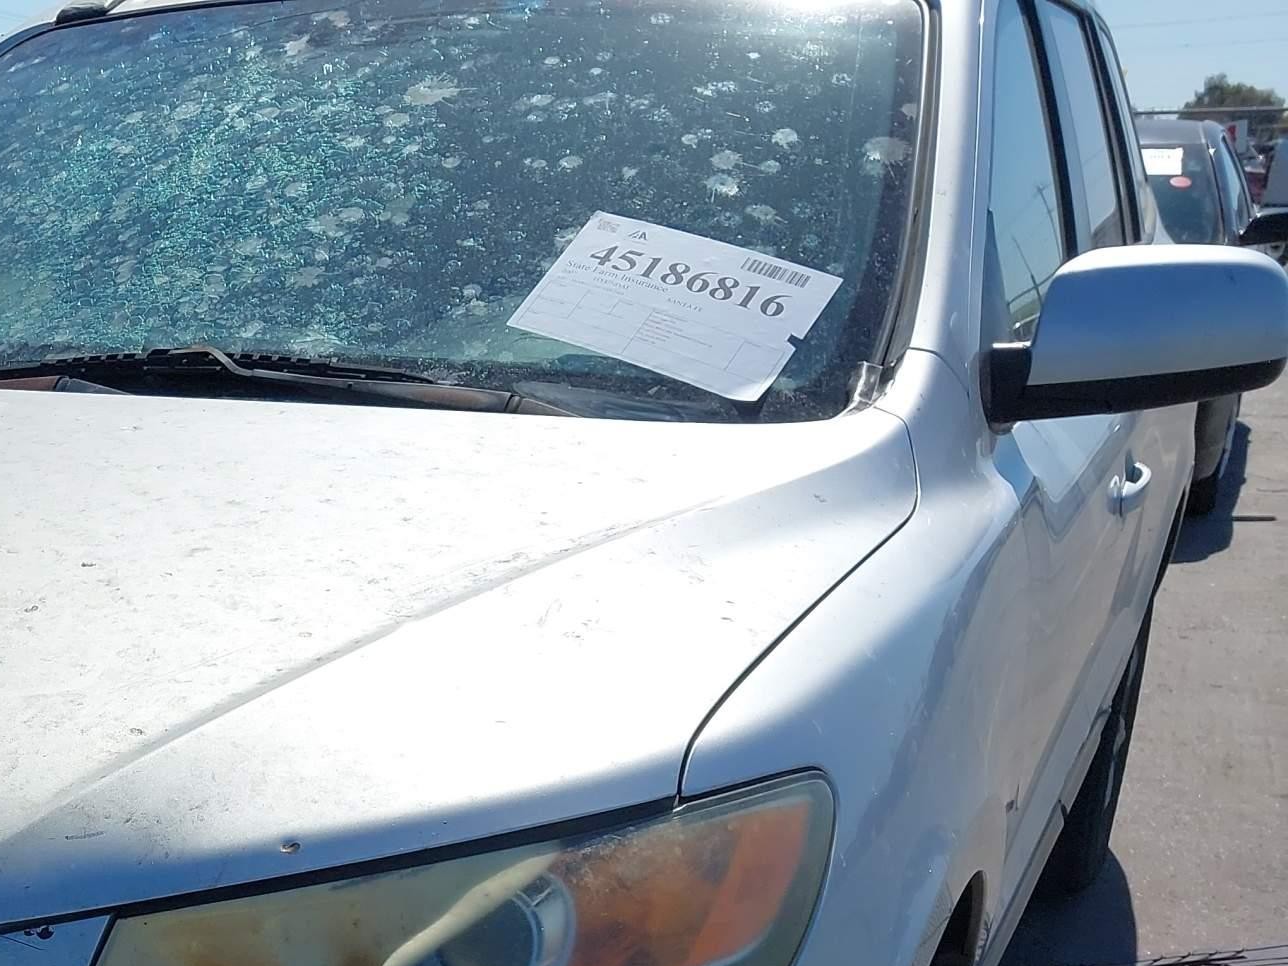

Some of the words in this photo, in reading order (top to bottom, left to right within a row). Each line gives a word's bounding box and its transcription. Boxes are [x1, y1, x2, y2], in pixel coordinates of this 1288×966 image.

[567, 259, 592, 272] State
[593, 263, 618, 279] Farm
[621, 274, 669, 293] Insurance
[590, 245, 793, 317] 45186816
